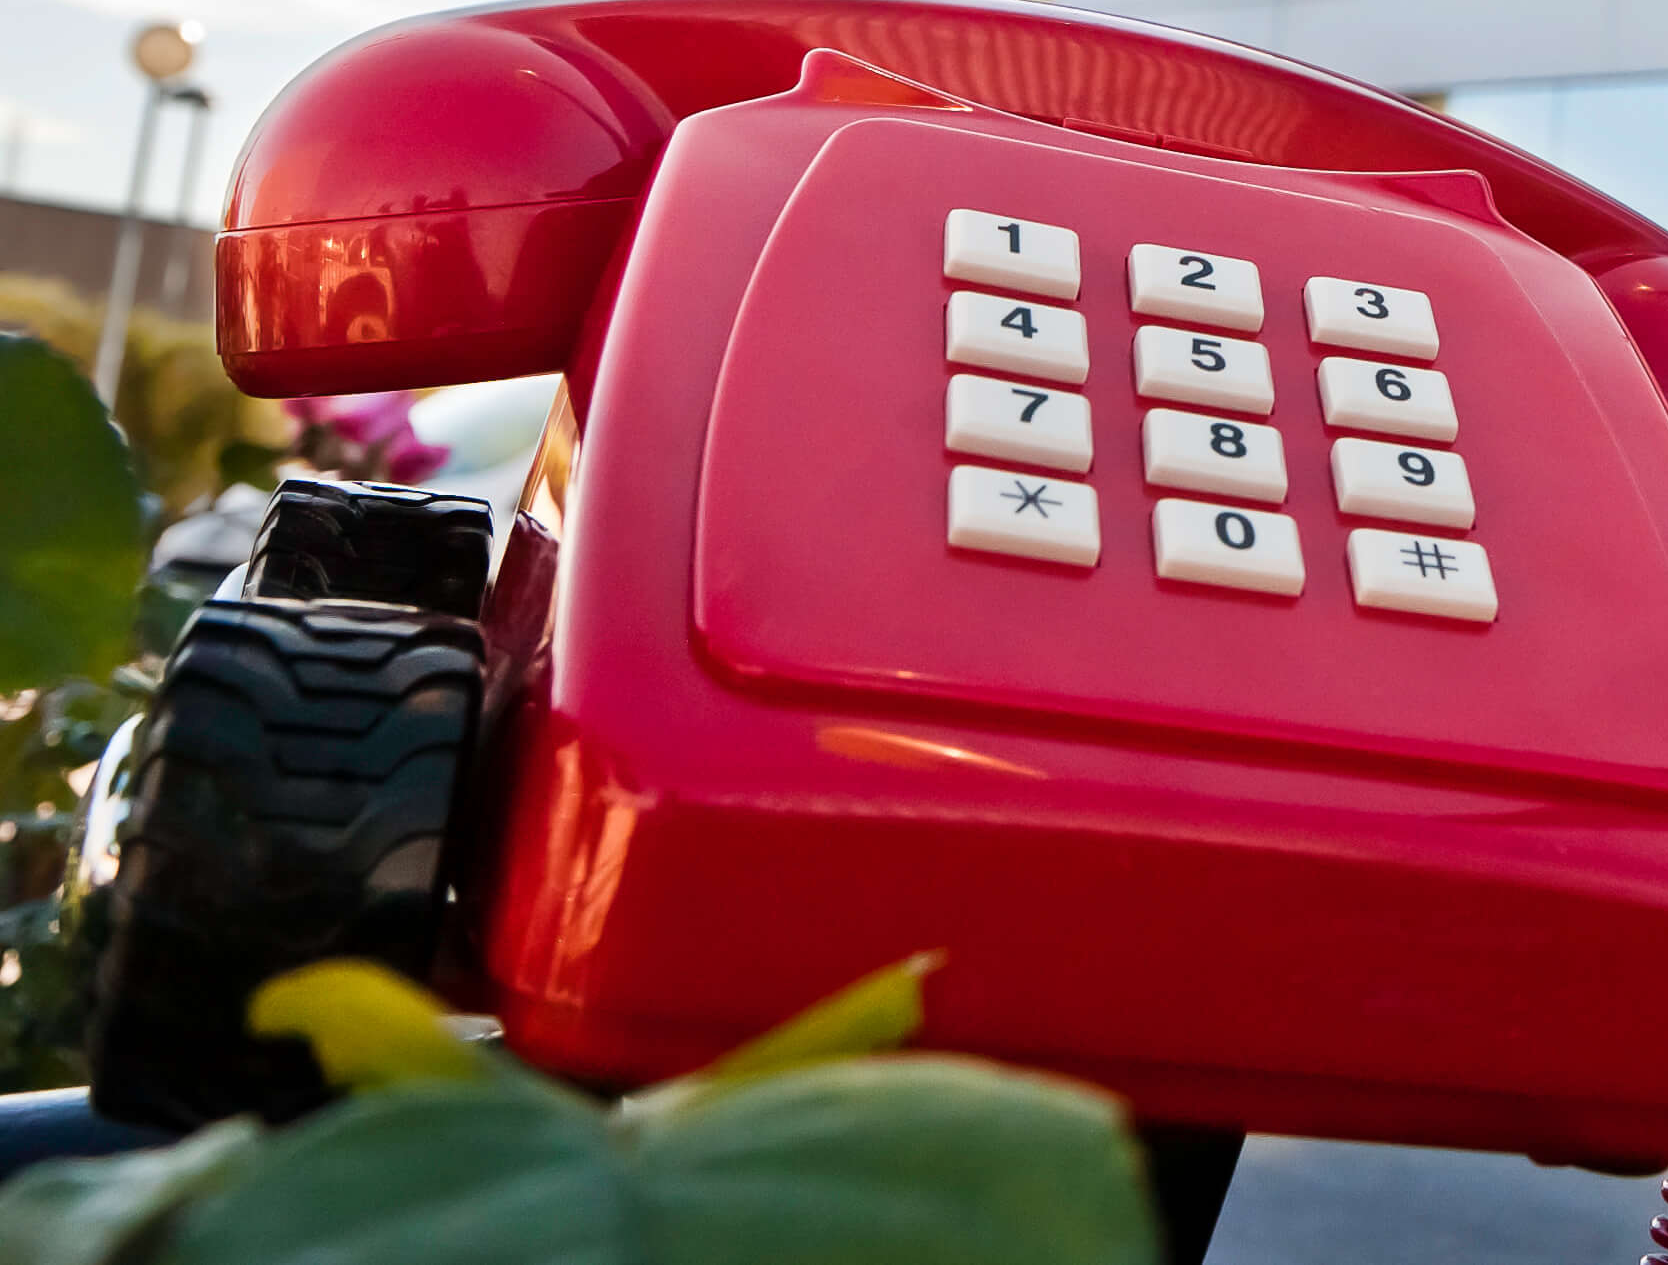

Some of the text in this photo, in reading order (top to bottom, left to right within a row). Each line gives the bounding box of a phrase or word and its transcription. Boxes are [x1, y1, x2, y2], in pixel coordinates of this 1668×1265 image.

[998, 222, 1390, 320] 1 2 3
[1000, 306, 1412, 402] 4 5 6
[1011, 388, 1436, 487] 7 8 9
[1215, 511, 1256, 551] 0
